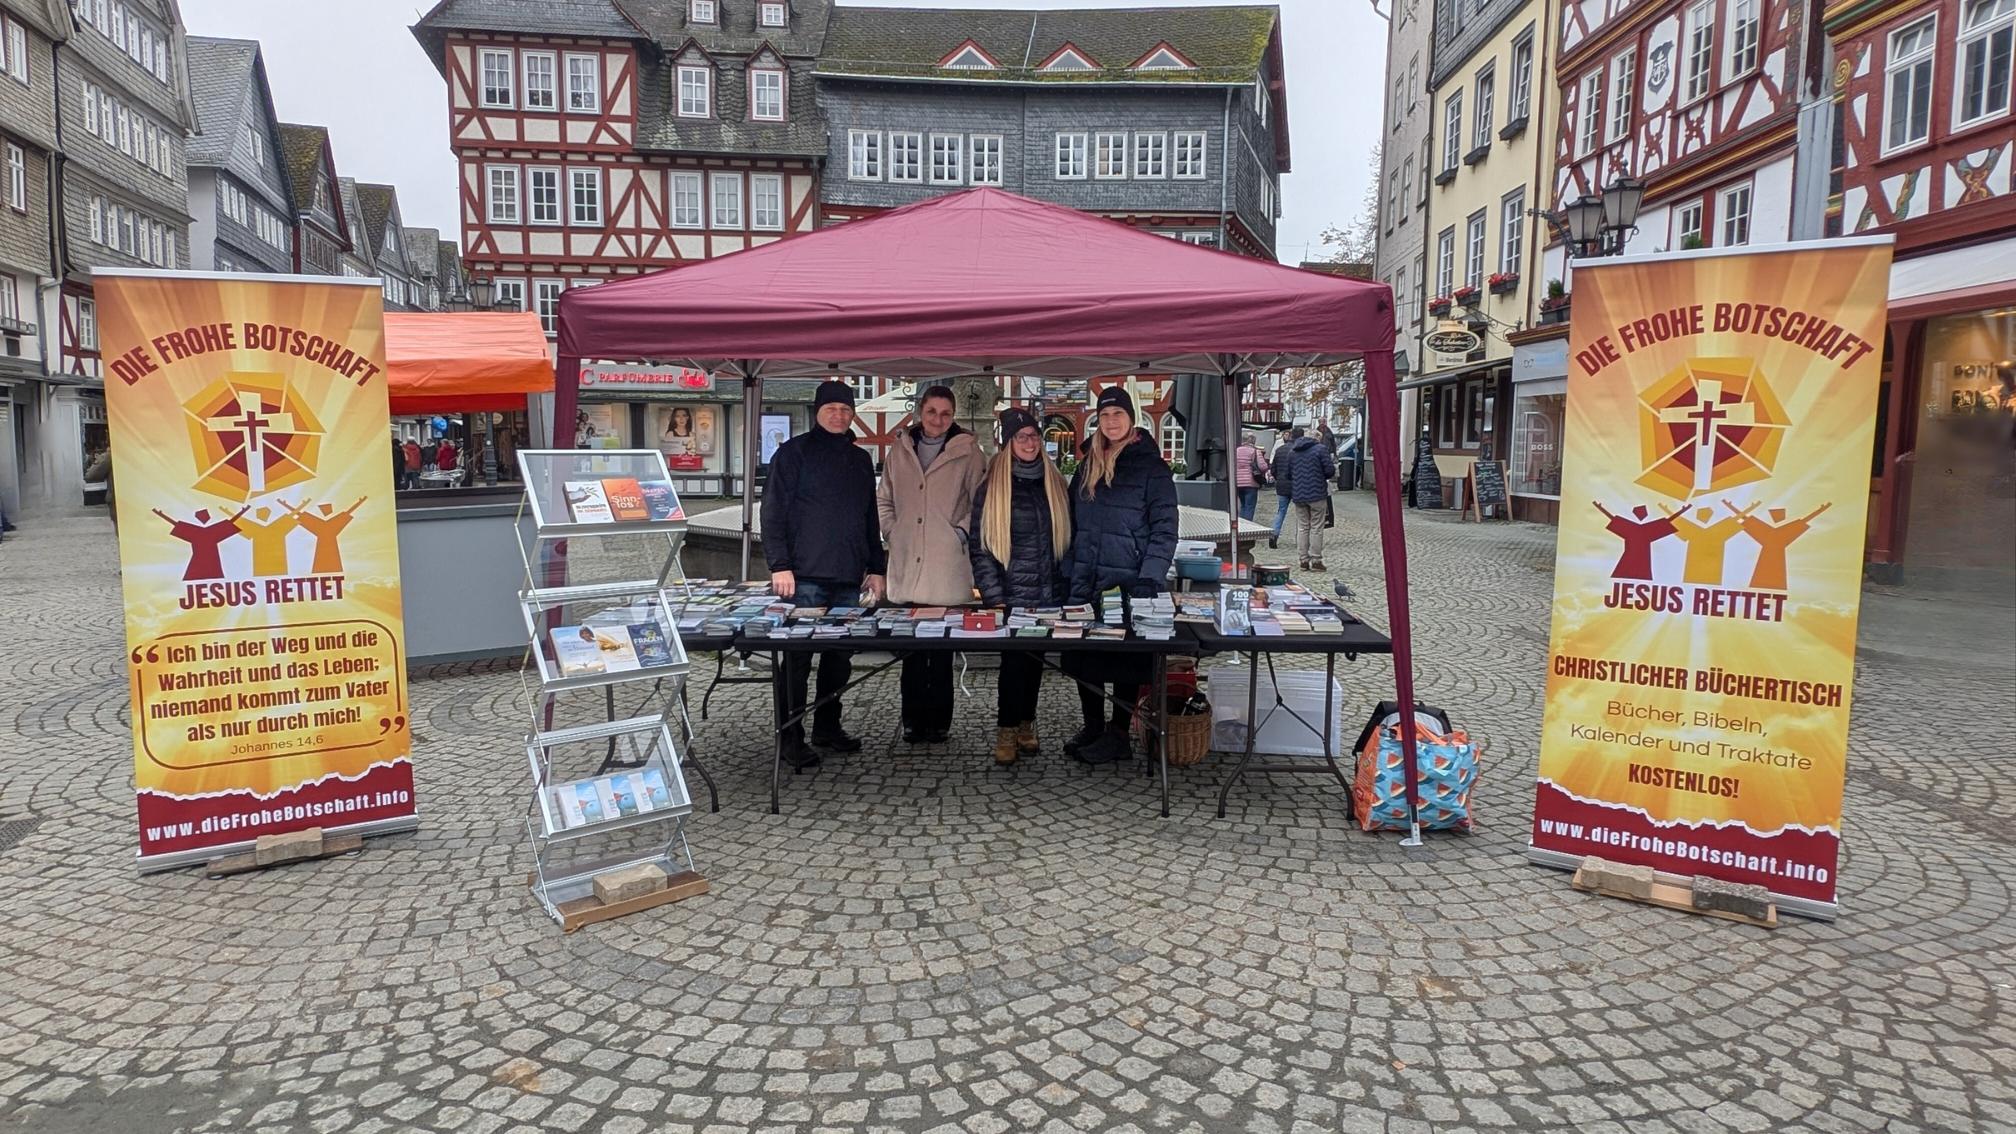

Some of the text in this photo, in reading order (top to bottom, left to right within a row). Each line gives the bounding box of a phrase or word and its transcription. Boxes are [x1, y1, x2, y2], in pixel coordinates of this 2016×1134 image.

[110, 322, 380, 387] DIE FROHE BOTSCHAFT
[1574, 302, 1875, 377] DIE FROHE BOTSCHAFT
[179, 575, 345, 610] JESUS RETTET
[1604, 582, 1788, 622] JESUS RETTET
[167, 629, 378, 664] Ich bin der Weg und die
[158, 655, 380, 692] Wahrheit und das Leben;
[1554, 654, 1843, 708] CHRISTLICHER BÜCHERTISCH
[150, 679, 390, 719] niemand kommt zum Vater
[1607, 699, 1768, 738] Bücher, Bibeln,
[187, 706, 362, 742] als nur durch mich!
[230, 735, 324, 756] Johannes 14,6
[1570, 723, 1813, 770] Kalender und Traktate
[1628, 763, 1740, 799] KOSTENLOS!
[147, 789, 409, 842] www.dieFroheBotschaft.info
[1540, 819, 1829, 884] www.dieFroheBotschaft.info
